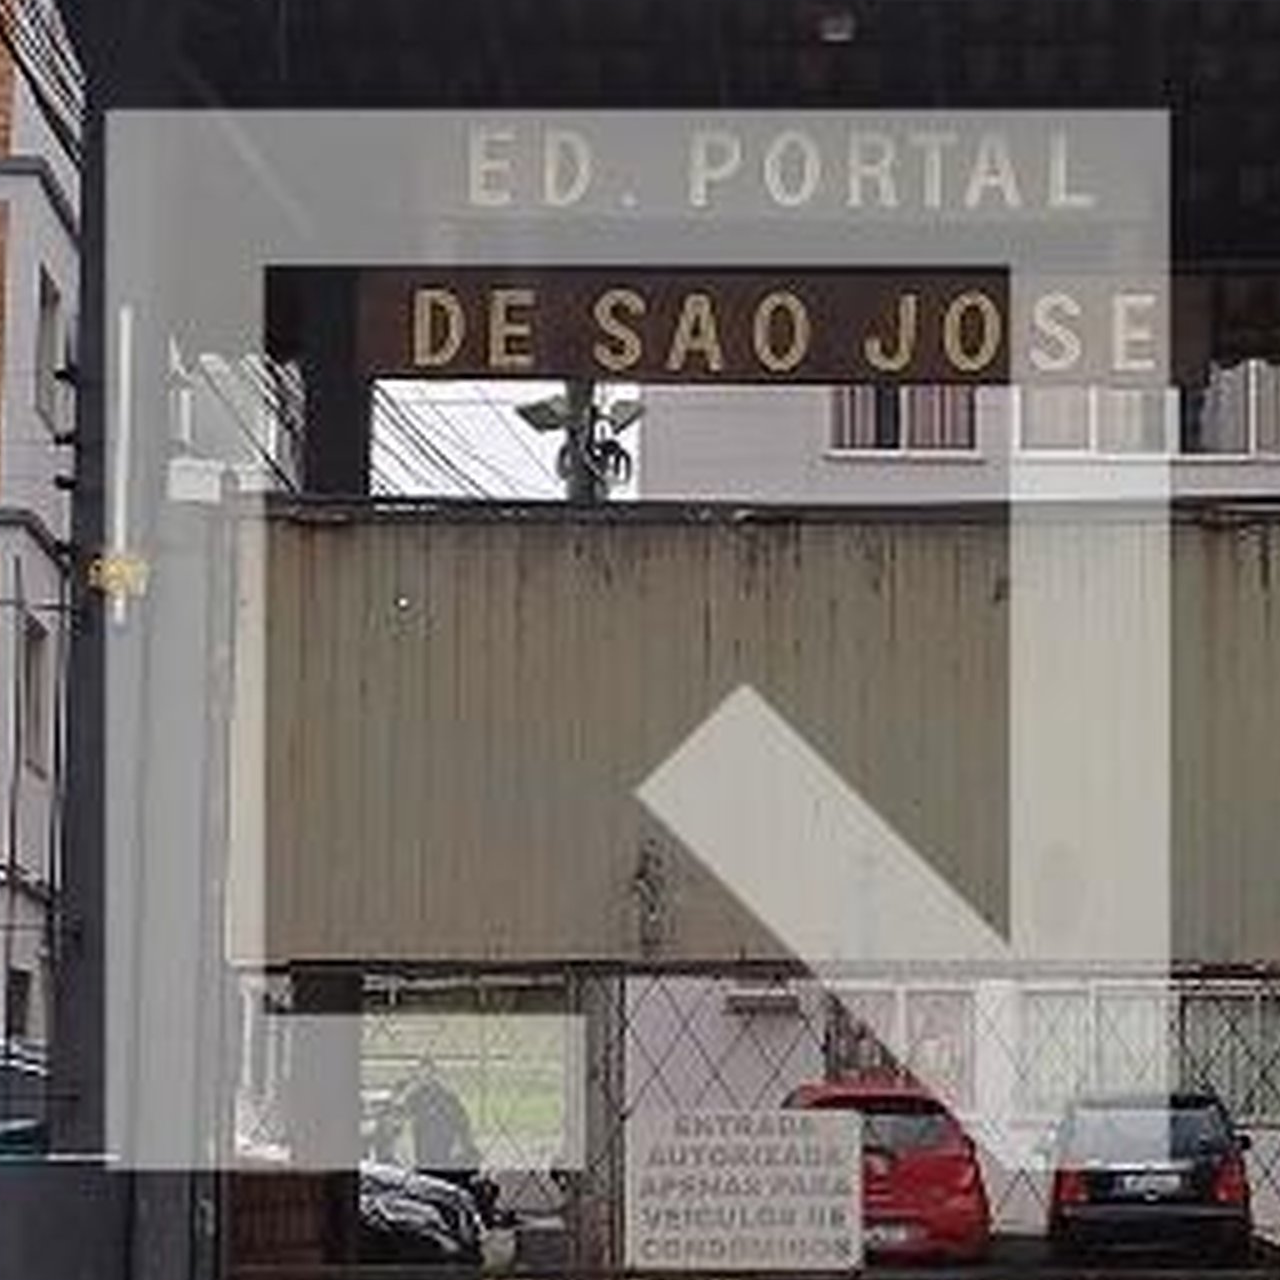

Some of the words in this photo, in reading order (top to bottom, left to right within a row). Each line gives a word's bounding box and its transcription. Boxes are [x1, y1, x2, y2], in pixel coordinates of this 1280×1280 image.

[466, 130, 639, 208] ED.
[687, 130, 1097, 208] PORTAL
[411, 289, 536, 371] DE
[592, 289, 811, 373] SAO
[863, 289, 1159, 373] JOSE
[673, 1114, 816, 1138] ENTRADA
[648, 1144, 843, 1167] AUTORIZADA
[639, 1174, 762, 1198] APENAS
